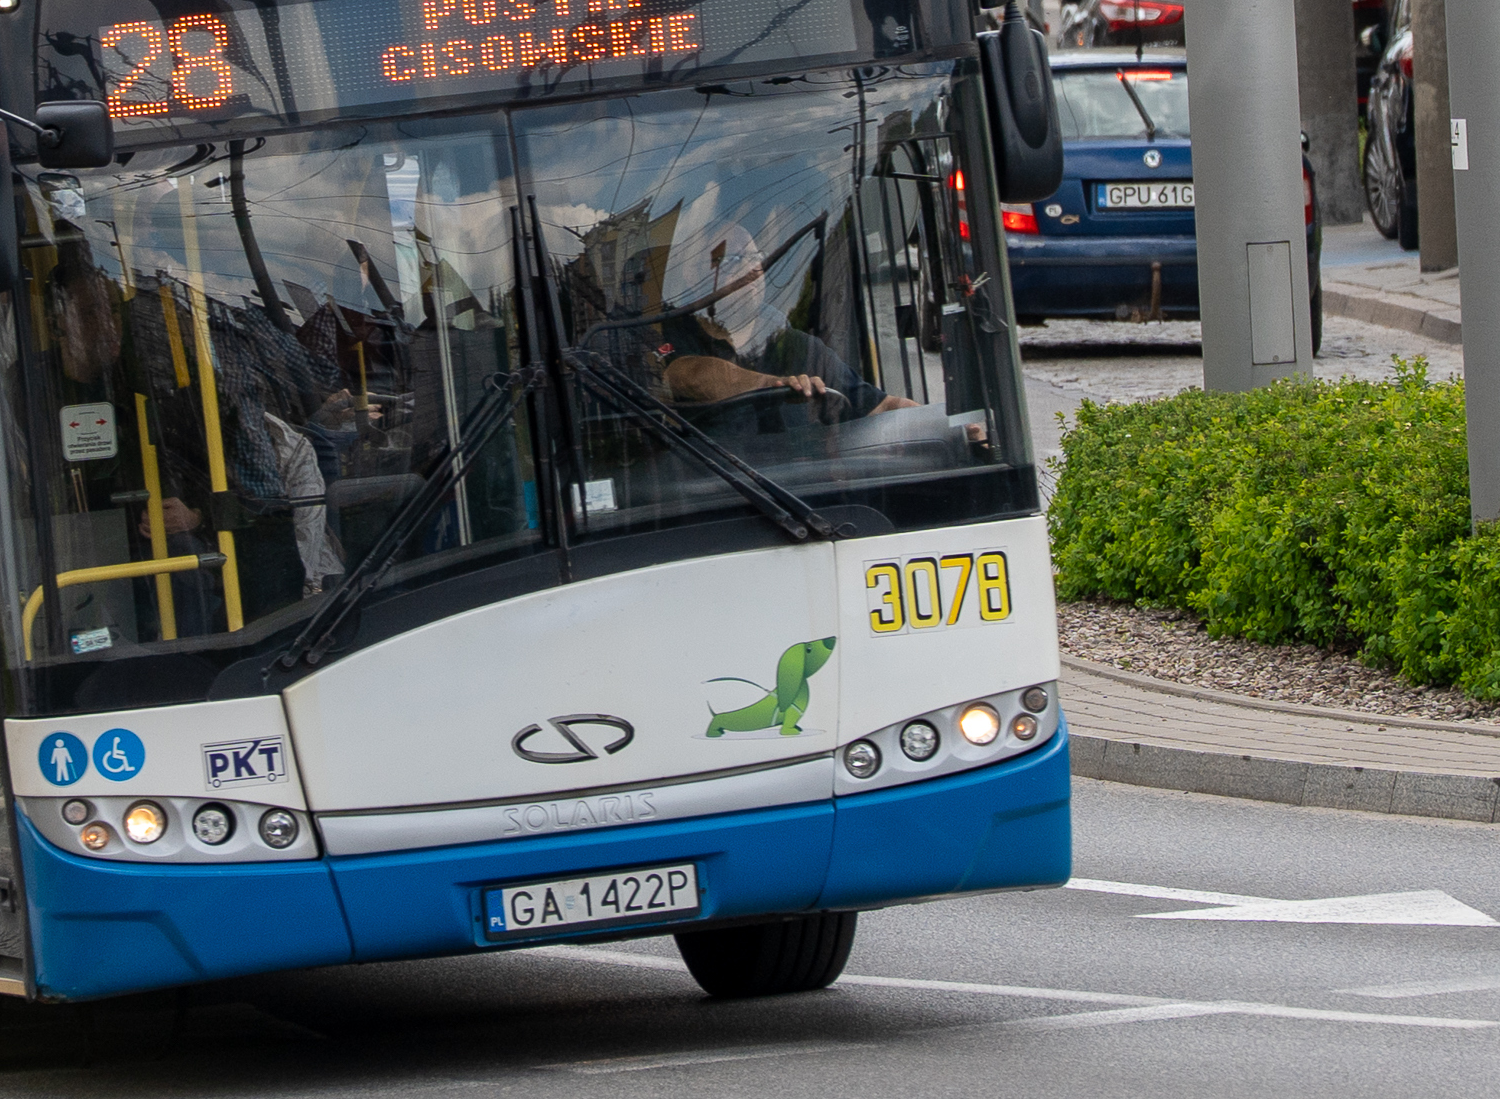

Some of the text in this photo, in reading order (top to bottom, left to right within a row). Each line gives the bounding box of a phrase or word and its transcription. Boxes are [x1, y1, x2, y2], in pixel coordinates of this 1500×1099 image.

[102, 13, 234, 119] 28
[382, 14, 698, 82] CISOWSKIE
[1109, 186, 1151, 205] GPU
[866, 550, 1012, 634] 3078
[208, 740, 279, 779] PKT
[503, 792, 657, 835] SOLARIS
[490, 870, 688, 928] PL GA 1422P
